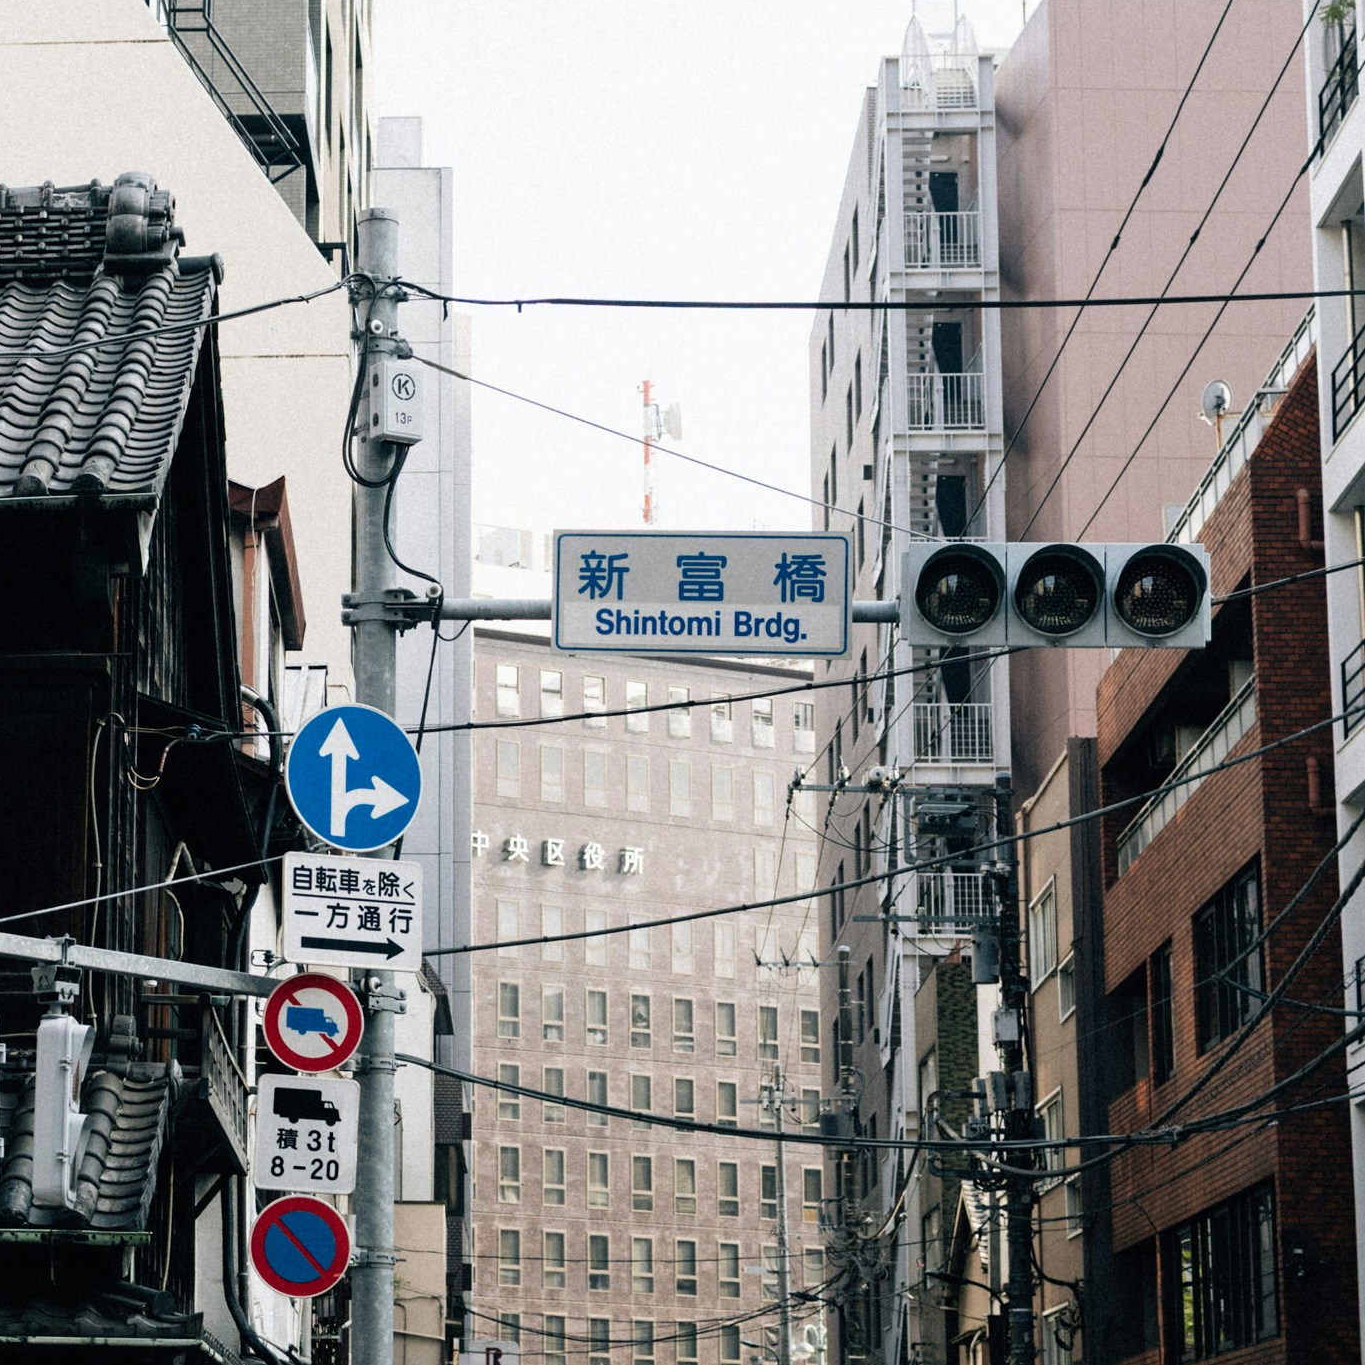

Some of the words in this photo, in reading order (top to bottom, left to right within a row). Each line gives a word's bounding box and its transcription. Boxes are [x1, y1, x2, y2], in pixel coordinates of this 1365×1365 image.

[578, 549, 827, 603] 新富橋
[595, 608, 721, 637] Shintomi
[733, 611, 807, 644] Brdg.
[471, 829, 644, 875] 中央区役所
[292, 864, 415, 899] 自転車を除く
[294, 903, 413, 934] 一方通行
[270, 1155, 339, 1181] 8-20
